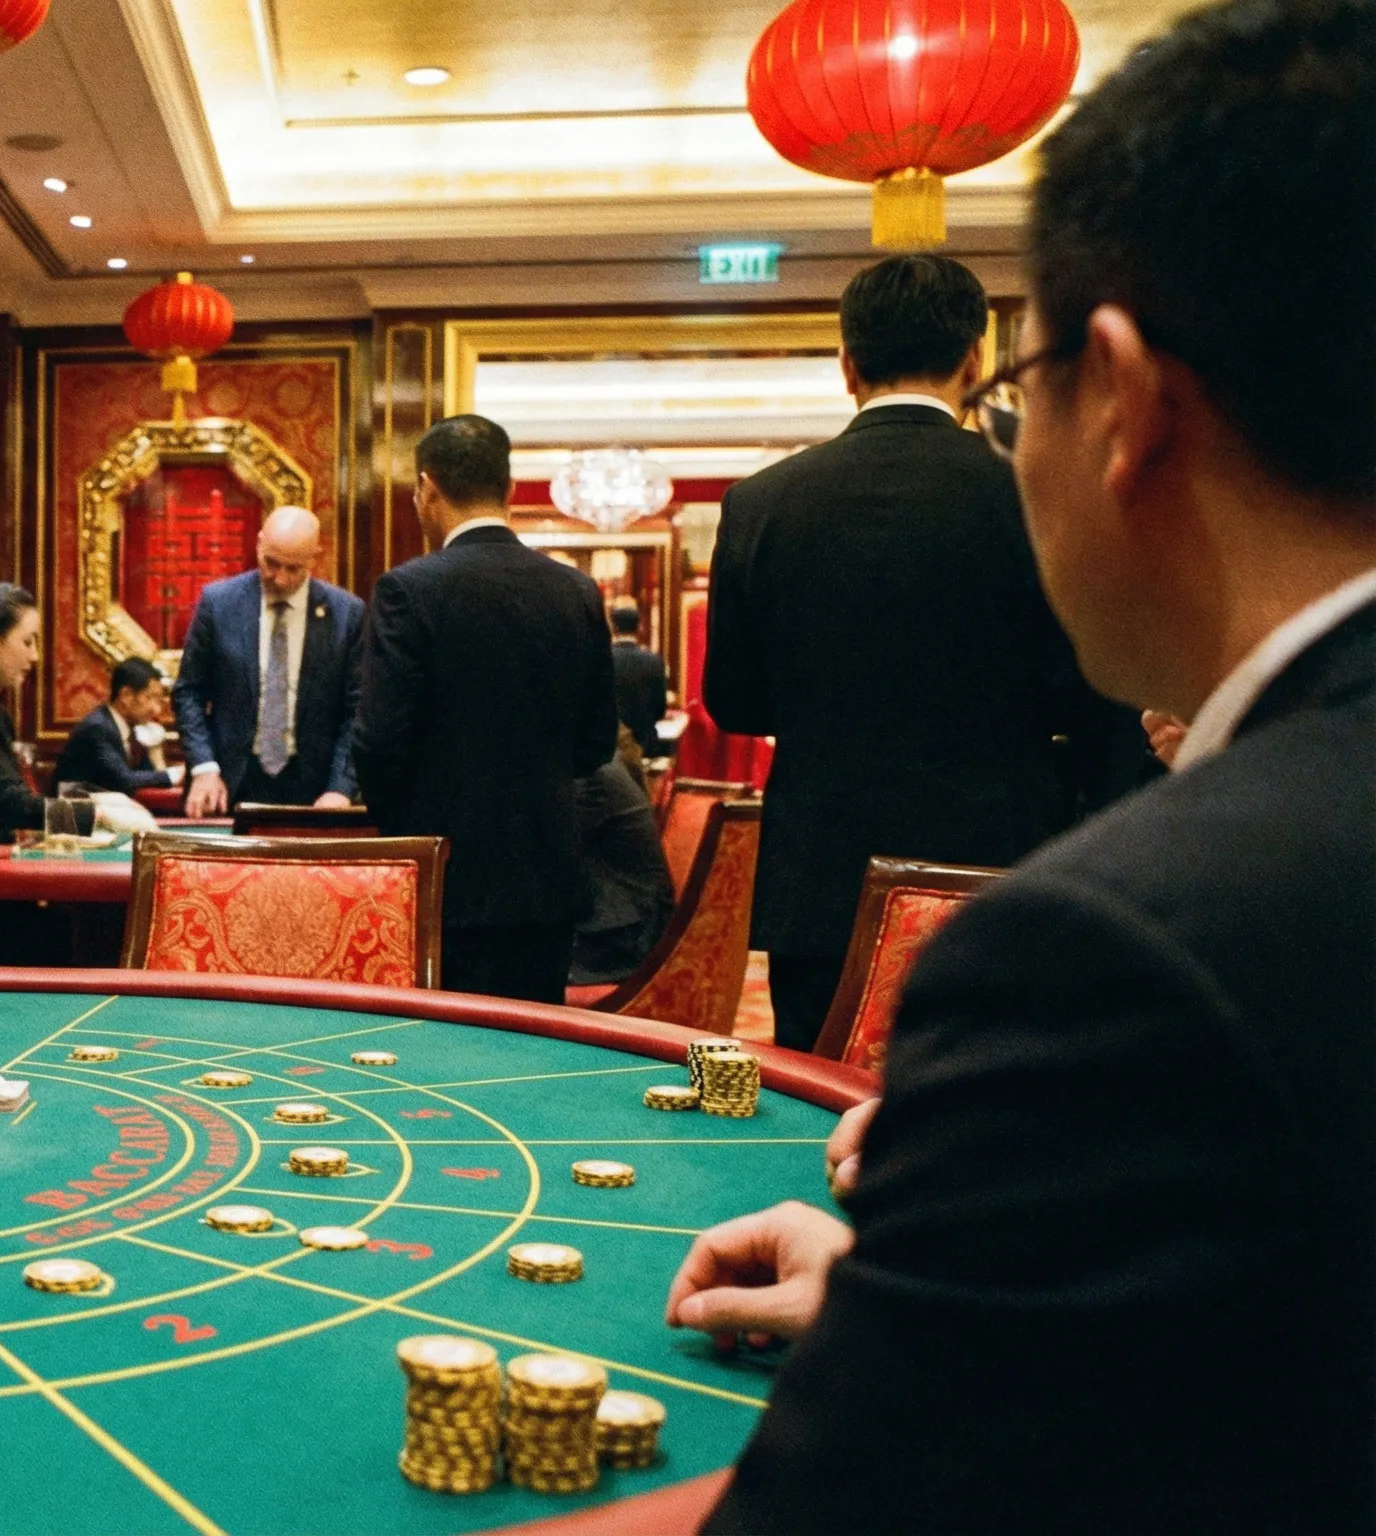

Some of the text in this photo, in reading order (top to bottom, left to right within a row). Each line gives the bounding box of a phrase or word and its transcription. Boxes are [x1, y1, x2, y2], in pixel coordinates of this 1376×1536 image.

[24, 1104, 170, 1211] BACCARAT
[441, 1167, 500, 1181] 4
[365, 1237, 434, 1261] 3
[143, 1314, 217, 1344] 2
